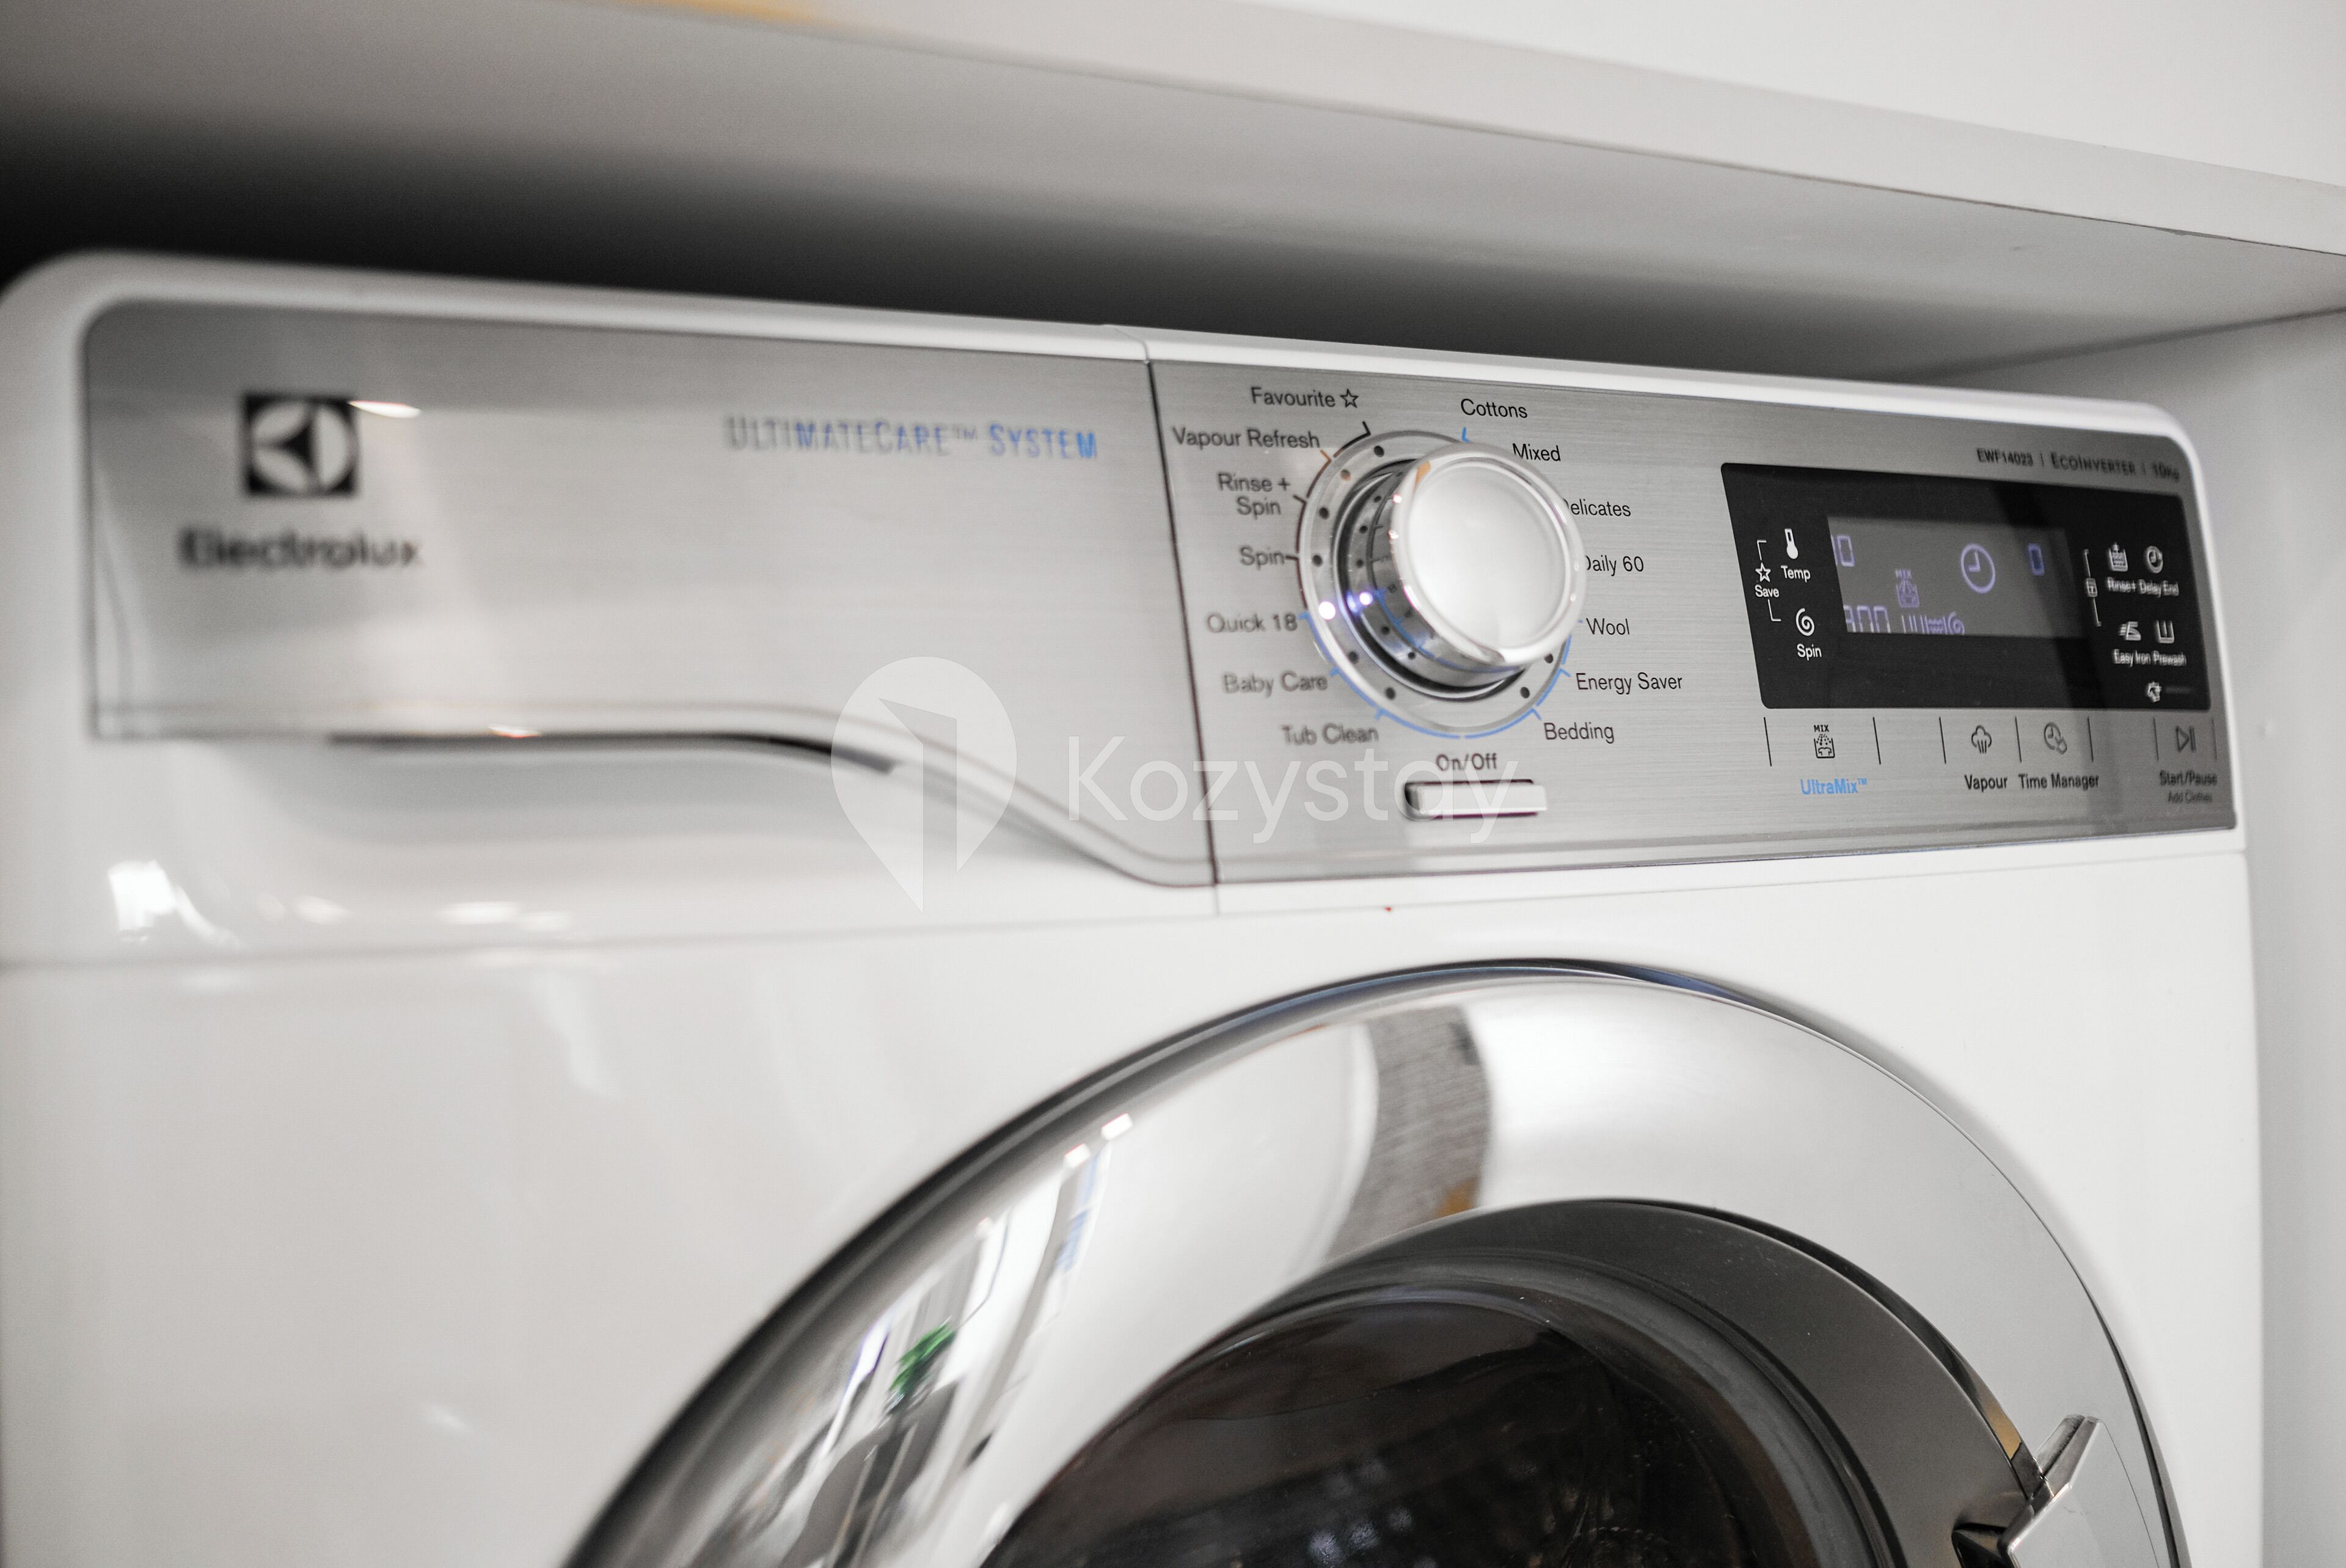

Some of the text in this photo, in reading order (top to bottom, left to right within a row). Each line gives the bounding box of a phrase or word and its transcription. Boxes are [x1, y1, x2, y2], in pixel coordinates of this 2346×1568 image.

[1251, 387, 1336, 407] Favourite
[1461, 398, 1528, 418] Cottons
[990, 421, 1098, 459] SYSTEM
[1172, 427, 1320, 450] Vapour Refresh
[1513, 443, 1561, 461] Mixed
[1218, 472, 1291, 492] Rinse +
[1237, 495, 1281, 520] Spin
[180, 524, 422, 571] Electrolux
[1240, 545, 1284, 571] Spin
[1623, 556, 1644, 572] 60
[1780, 565, 1811, 583] Temp
[1755, 585, 1779, 598] Save
[2139, 578, 2161, 598] Delay
[2163, 581, 2179, 597] End
[1207, 612, 1298, 633] Quick 18
[1586, 618, 1630, 635] Wool
[1797, 643, 1822, 661] Spin
[2113, 649, 2187, 668] Easy Iron Prewash
[1223, 670, 1329, 698] Baby Care
[1576, 672, 1683, 695] Energy Saver
[1282, 723, 1379, 745] Tub Clean
[1544, 722, 1615, 744] Bedding
[1813, 724, 1830, 733] MIX
[1436, 752, 1498, 771] On/Off
[1964, 774, 2008, 793] Vapour
[2018, 771, 2100, 791] Time Manager
[2158, 769, 2218, 786] Start/Pause
